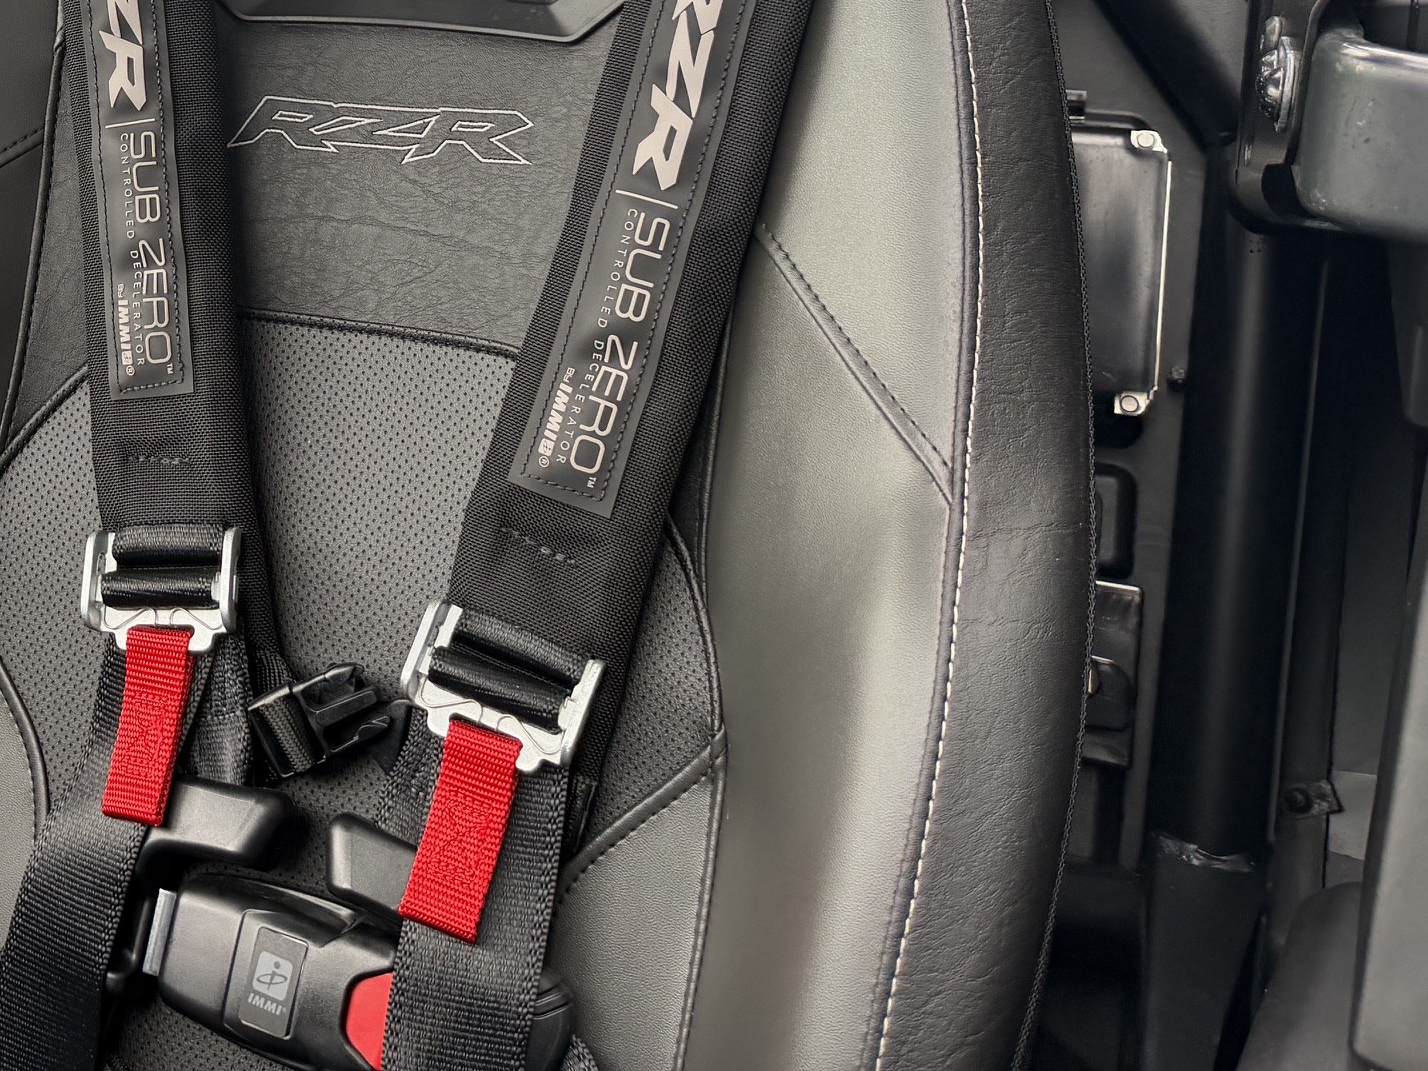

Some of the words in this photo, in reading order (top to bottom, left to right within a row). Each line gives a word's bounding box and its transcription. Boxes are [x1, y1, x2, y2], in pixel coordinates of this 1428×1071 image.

[120, 132, 135, 239] CONTROLLED
[130, 130, 162, 224] SUB
[227, 95, 535, 165] RZR
[130, 250, 145, 366] DECELERATOR
[137, 238, 173, 365] ZERO
[598, 208, 638, 328] CONTROLLED
[615, 211, 671, 322] SUB
[543, 382, 574, 441] IMMI
[557, 340, 605, 463] DECELERATOR
[569, 334, 639, 475] ZERO
[247, 992, 283, 1016] IMMI
